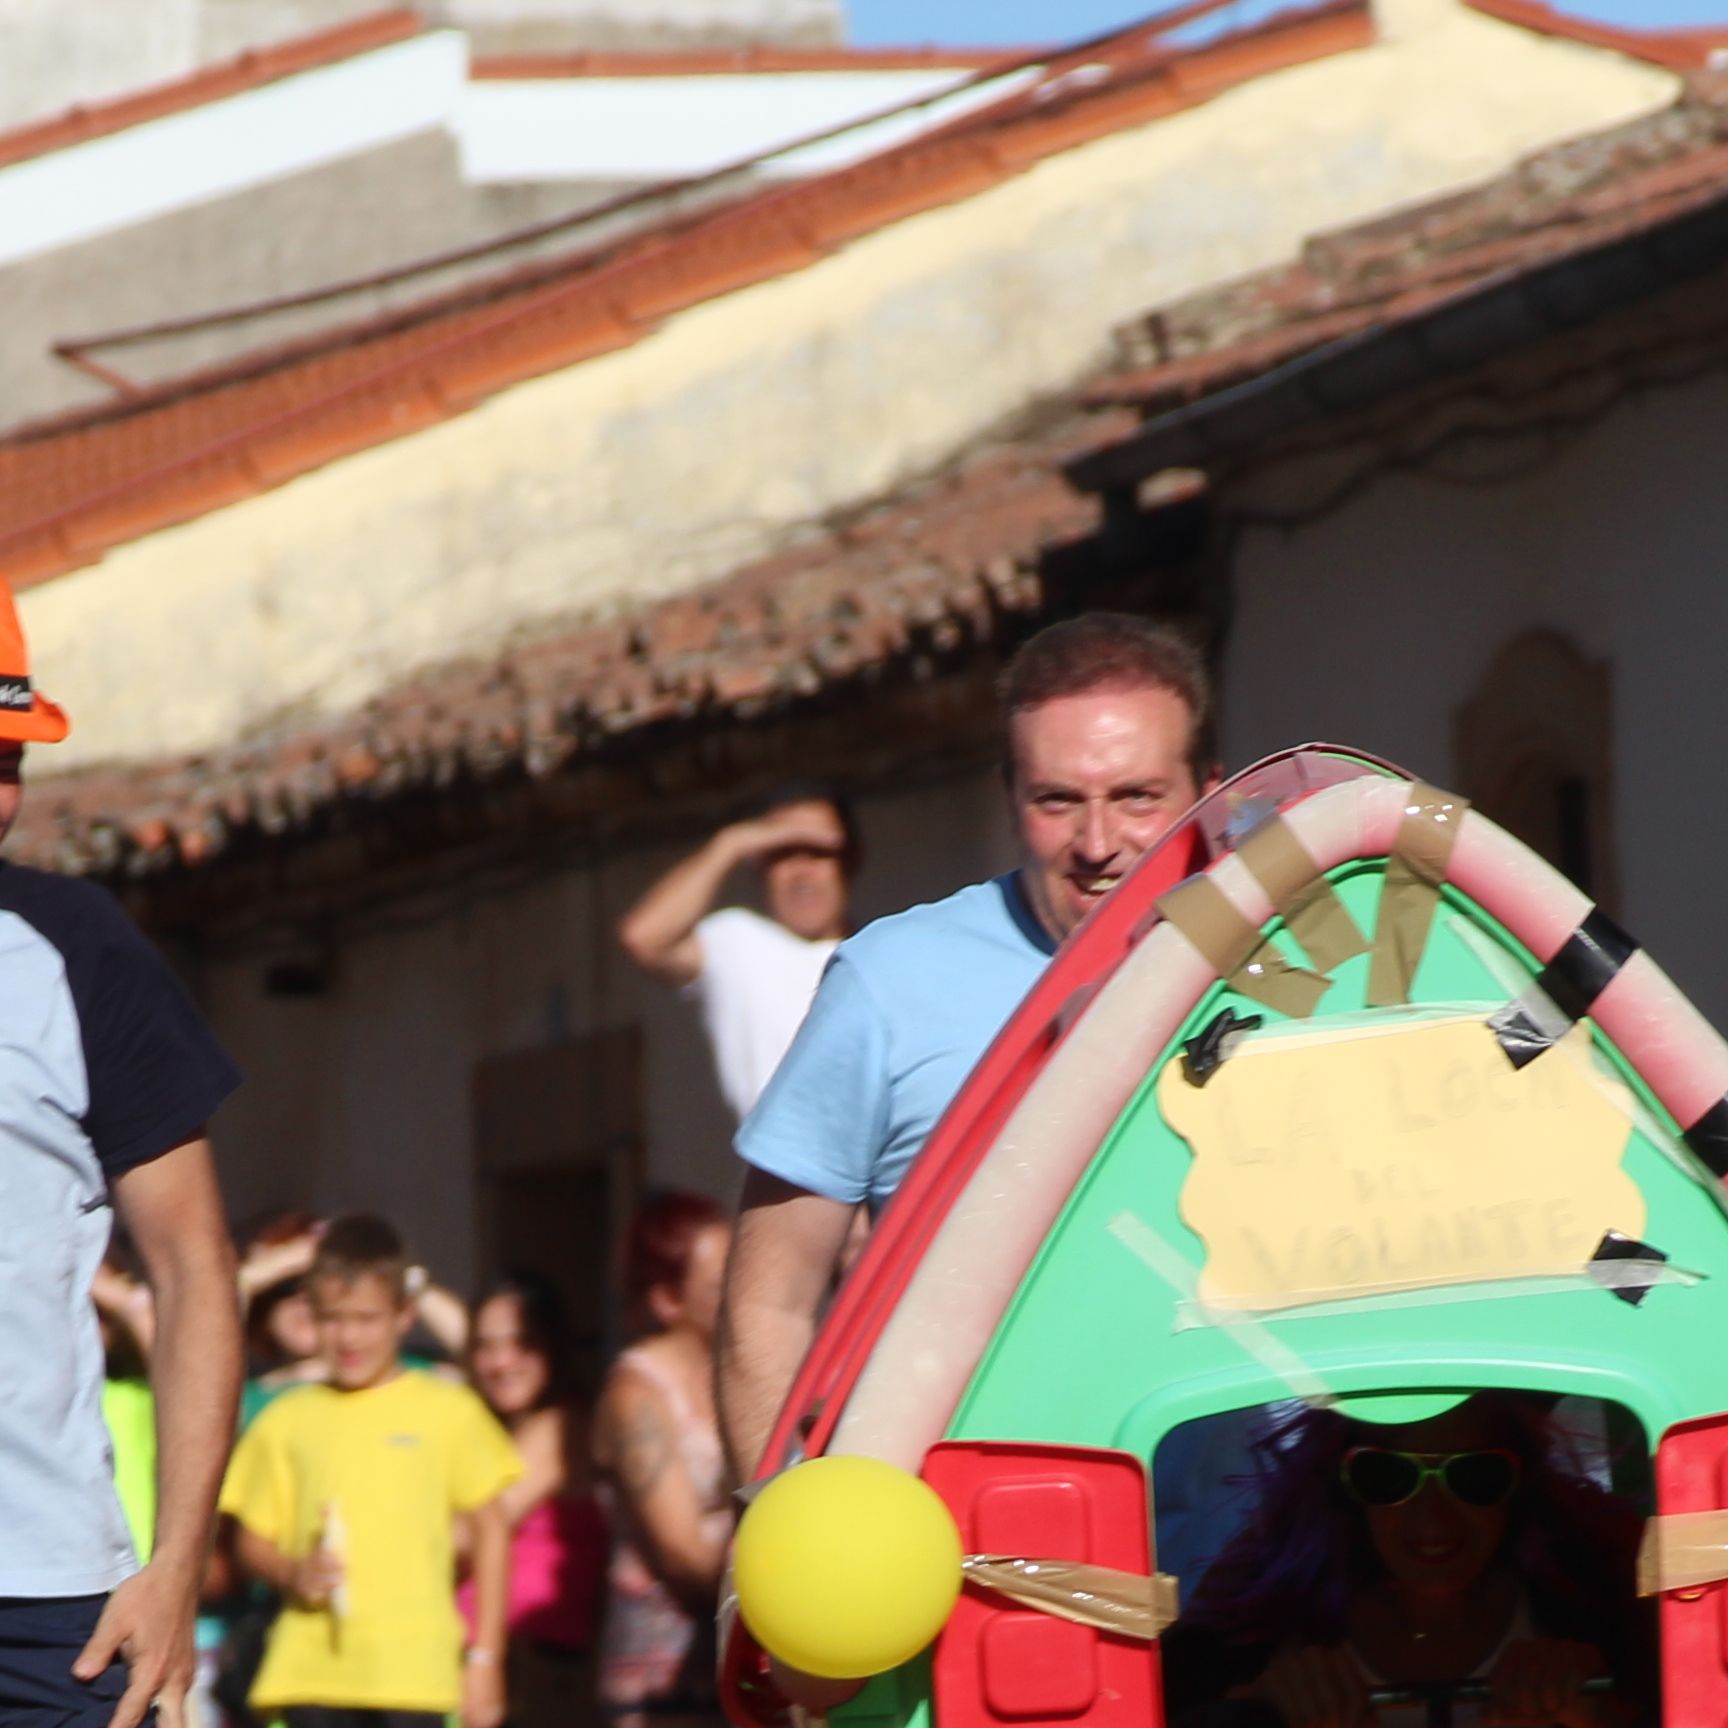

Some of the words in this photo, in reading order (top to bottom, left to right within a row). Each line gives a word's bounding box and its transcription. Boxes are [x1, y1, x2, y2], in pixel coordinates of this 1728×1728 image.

[1208, 1066, 1344, 1169] LA
[1382, 1053, 1572, 1135] LOCA
[1350, 1162, 1444, 1206] DEL
[1236, 1196, 1590, 1290] VOLANTE
